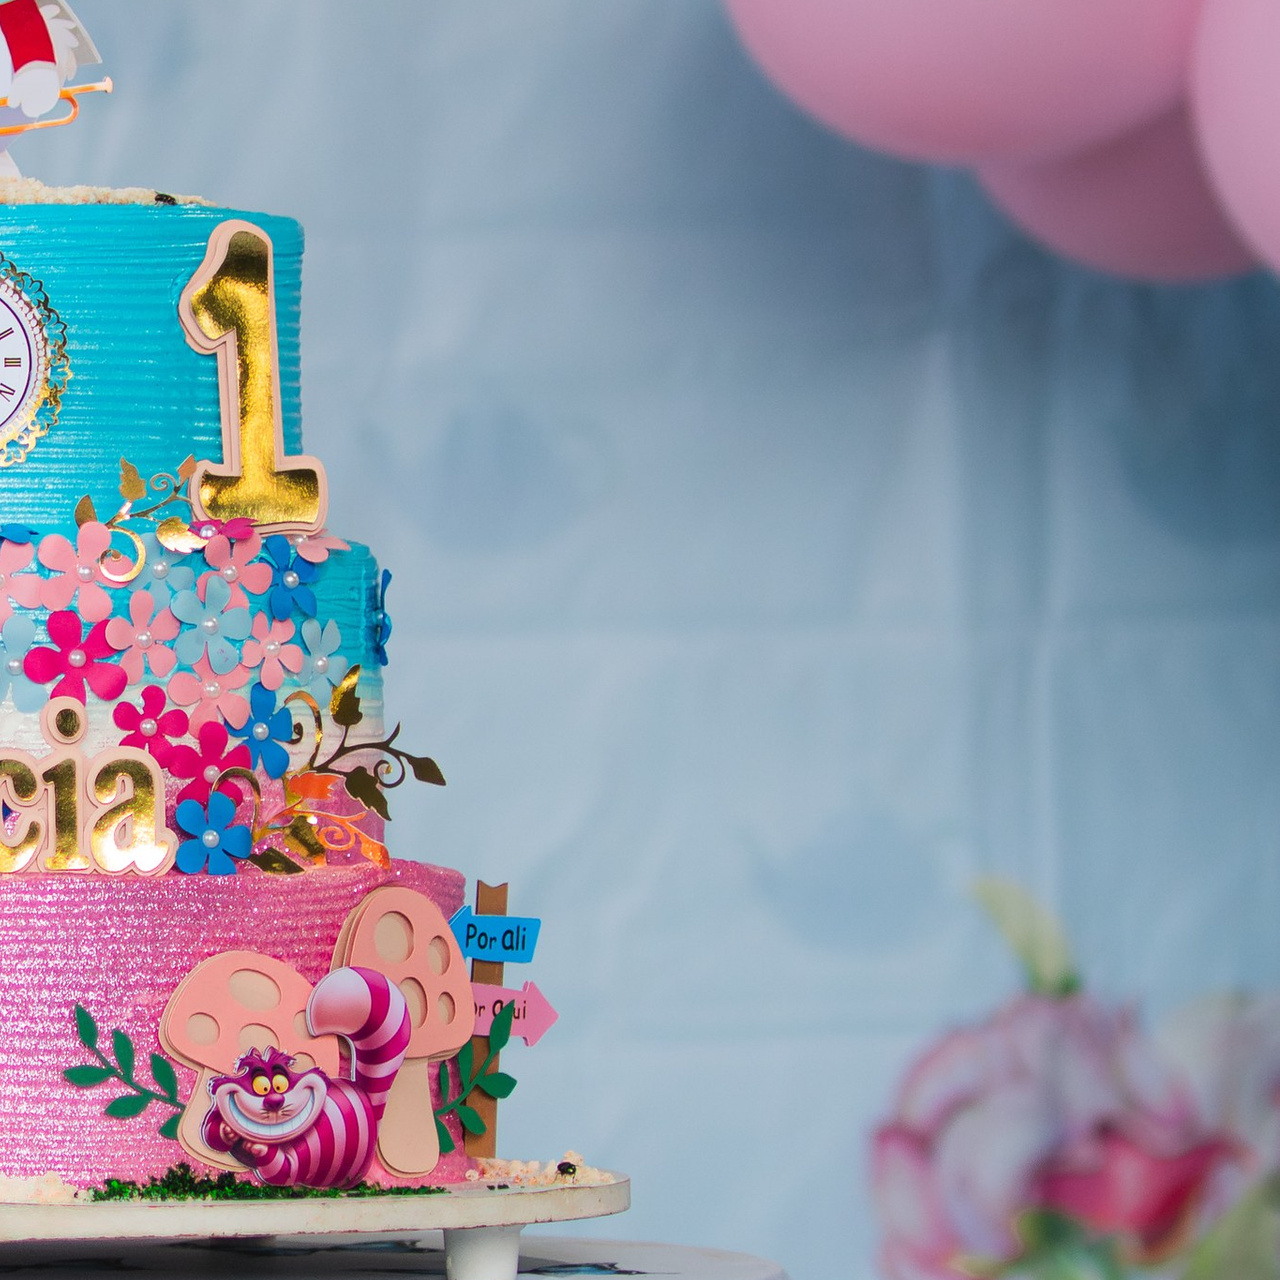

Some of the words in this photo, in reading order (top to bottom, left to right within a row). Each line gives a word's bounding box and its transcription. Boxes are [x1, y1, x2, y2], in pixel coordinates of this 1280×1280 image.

[4, 357, 21, 367] III
[188, 226, 321, 526] 1
[465, 923, 497, 950] Por
